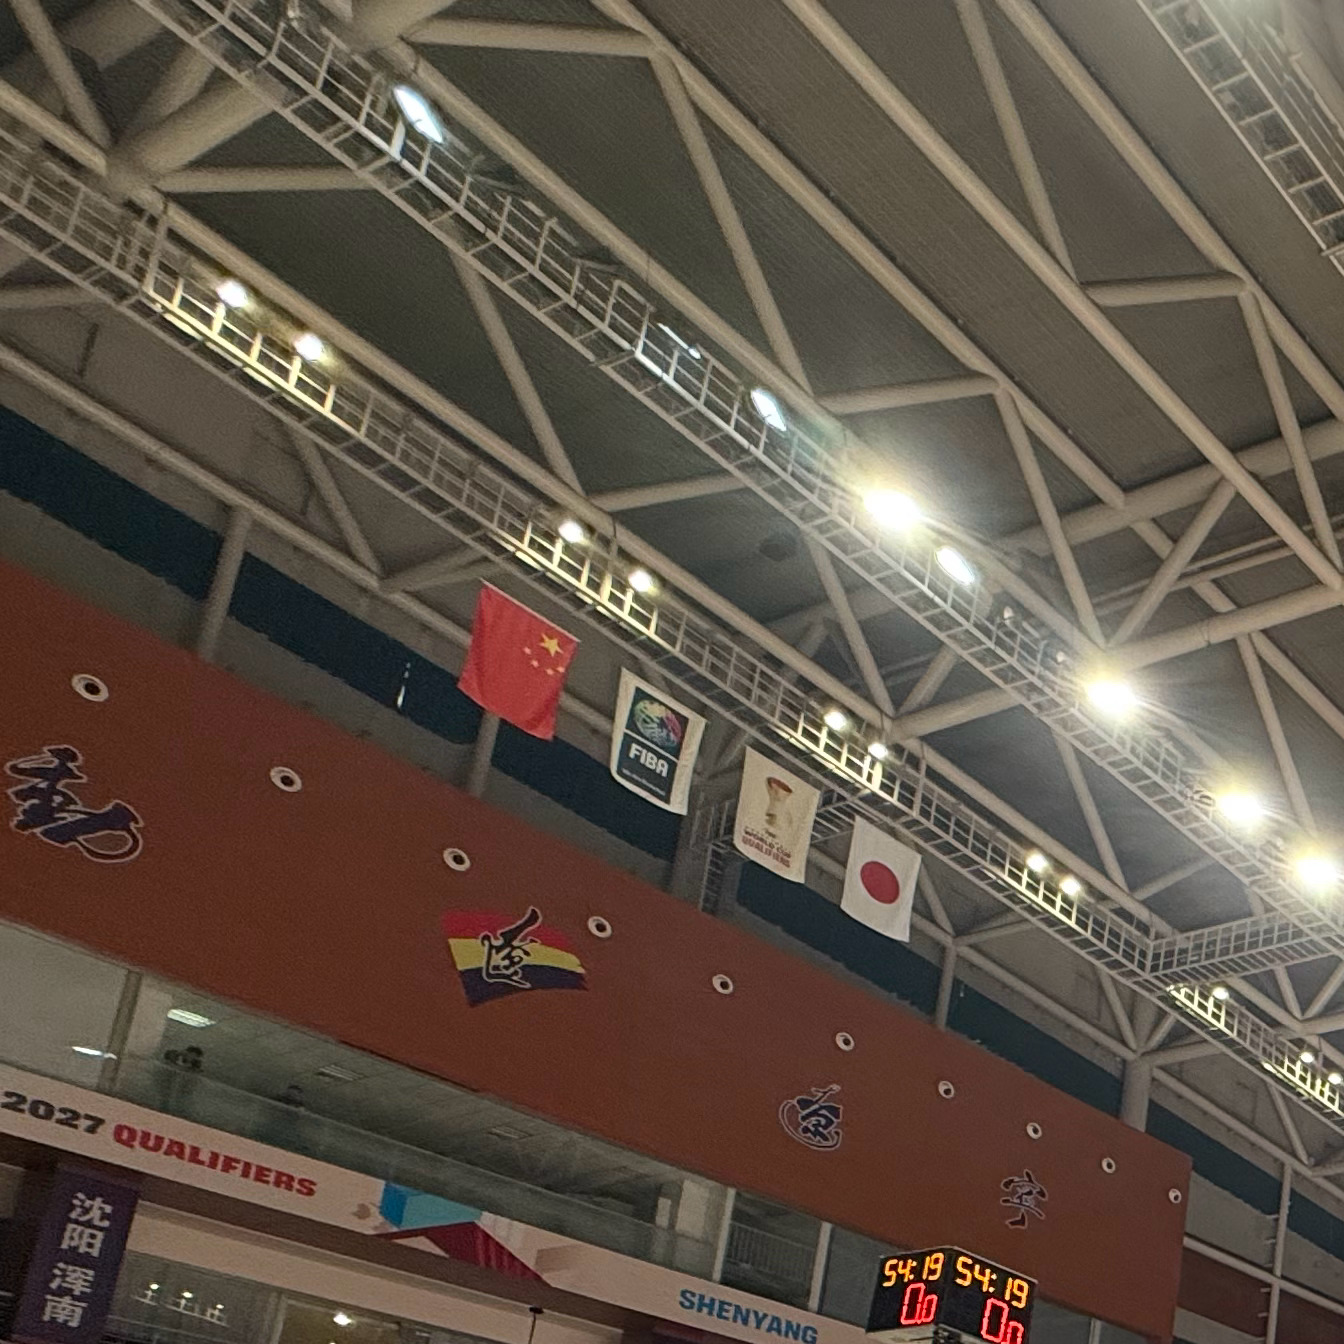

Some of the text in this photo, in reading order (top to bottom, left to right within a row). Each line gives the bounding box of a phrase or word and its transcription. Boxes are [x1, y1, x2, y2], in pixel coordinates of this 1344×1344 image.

[629, 743, 669, 777] FIBA
[1, 1091, 317, 1197] 2027 QUALIFIERS
[882, 1252, 945, 1287] 54:19
[954, 1256, 1029, 1309] 54:19
